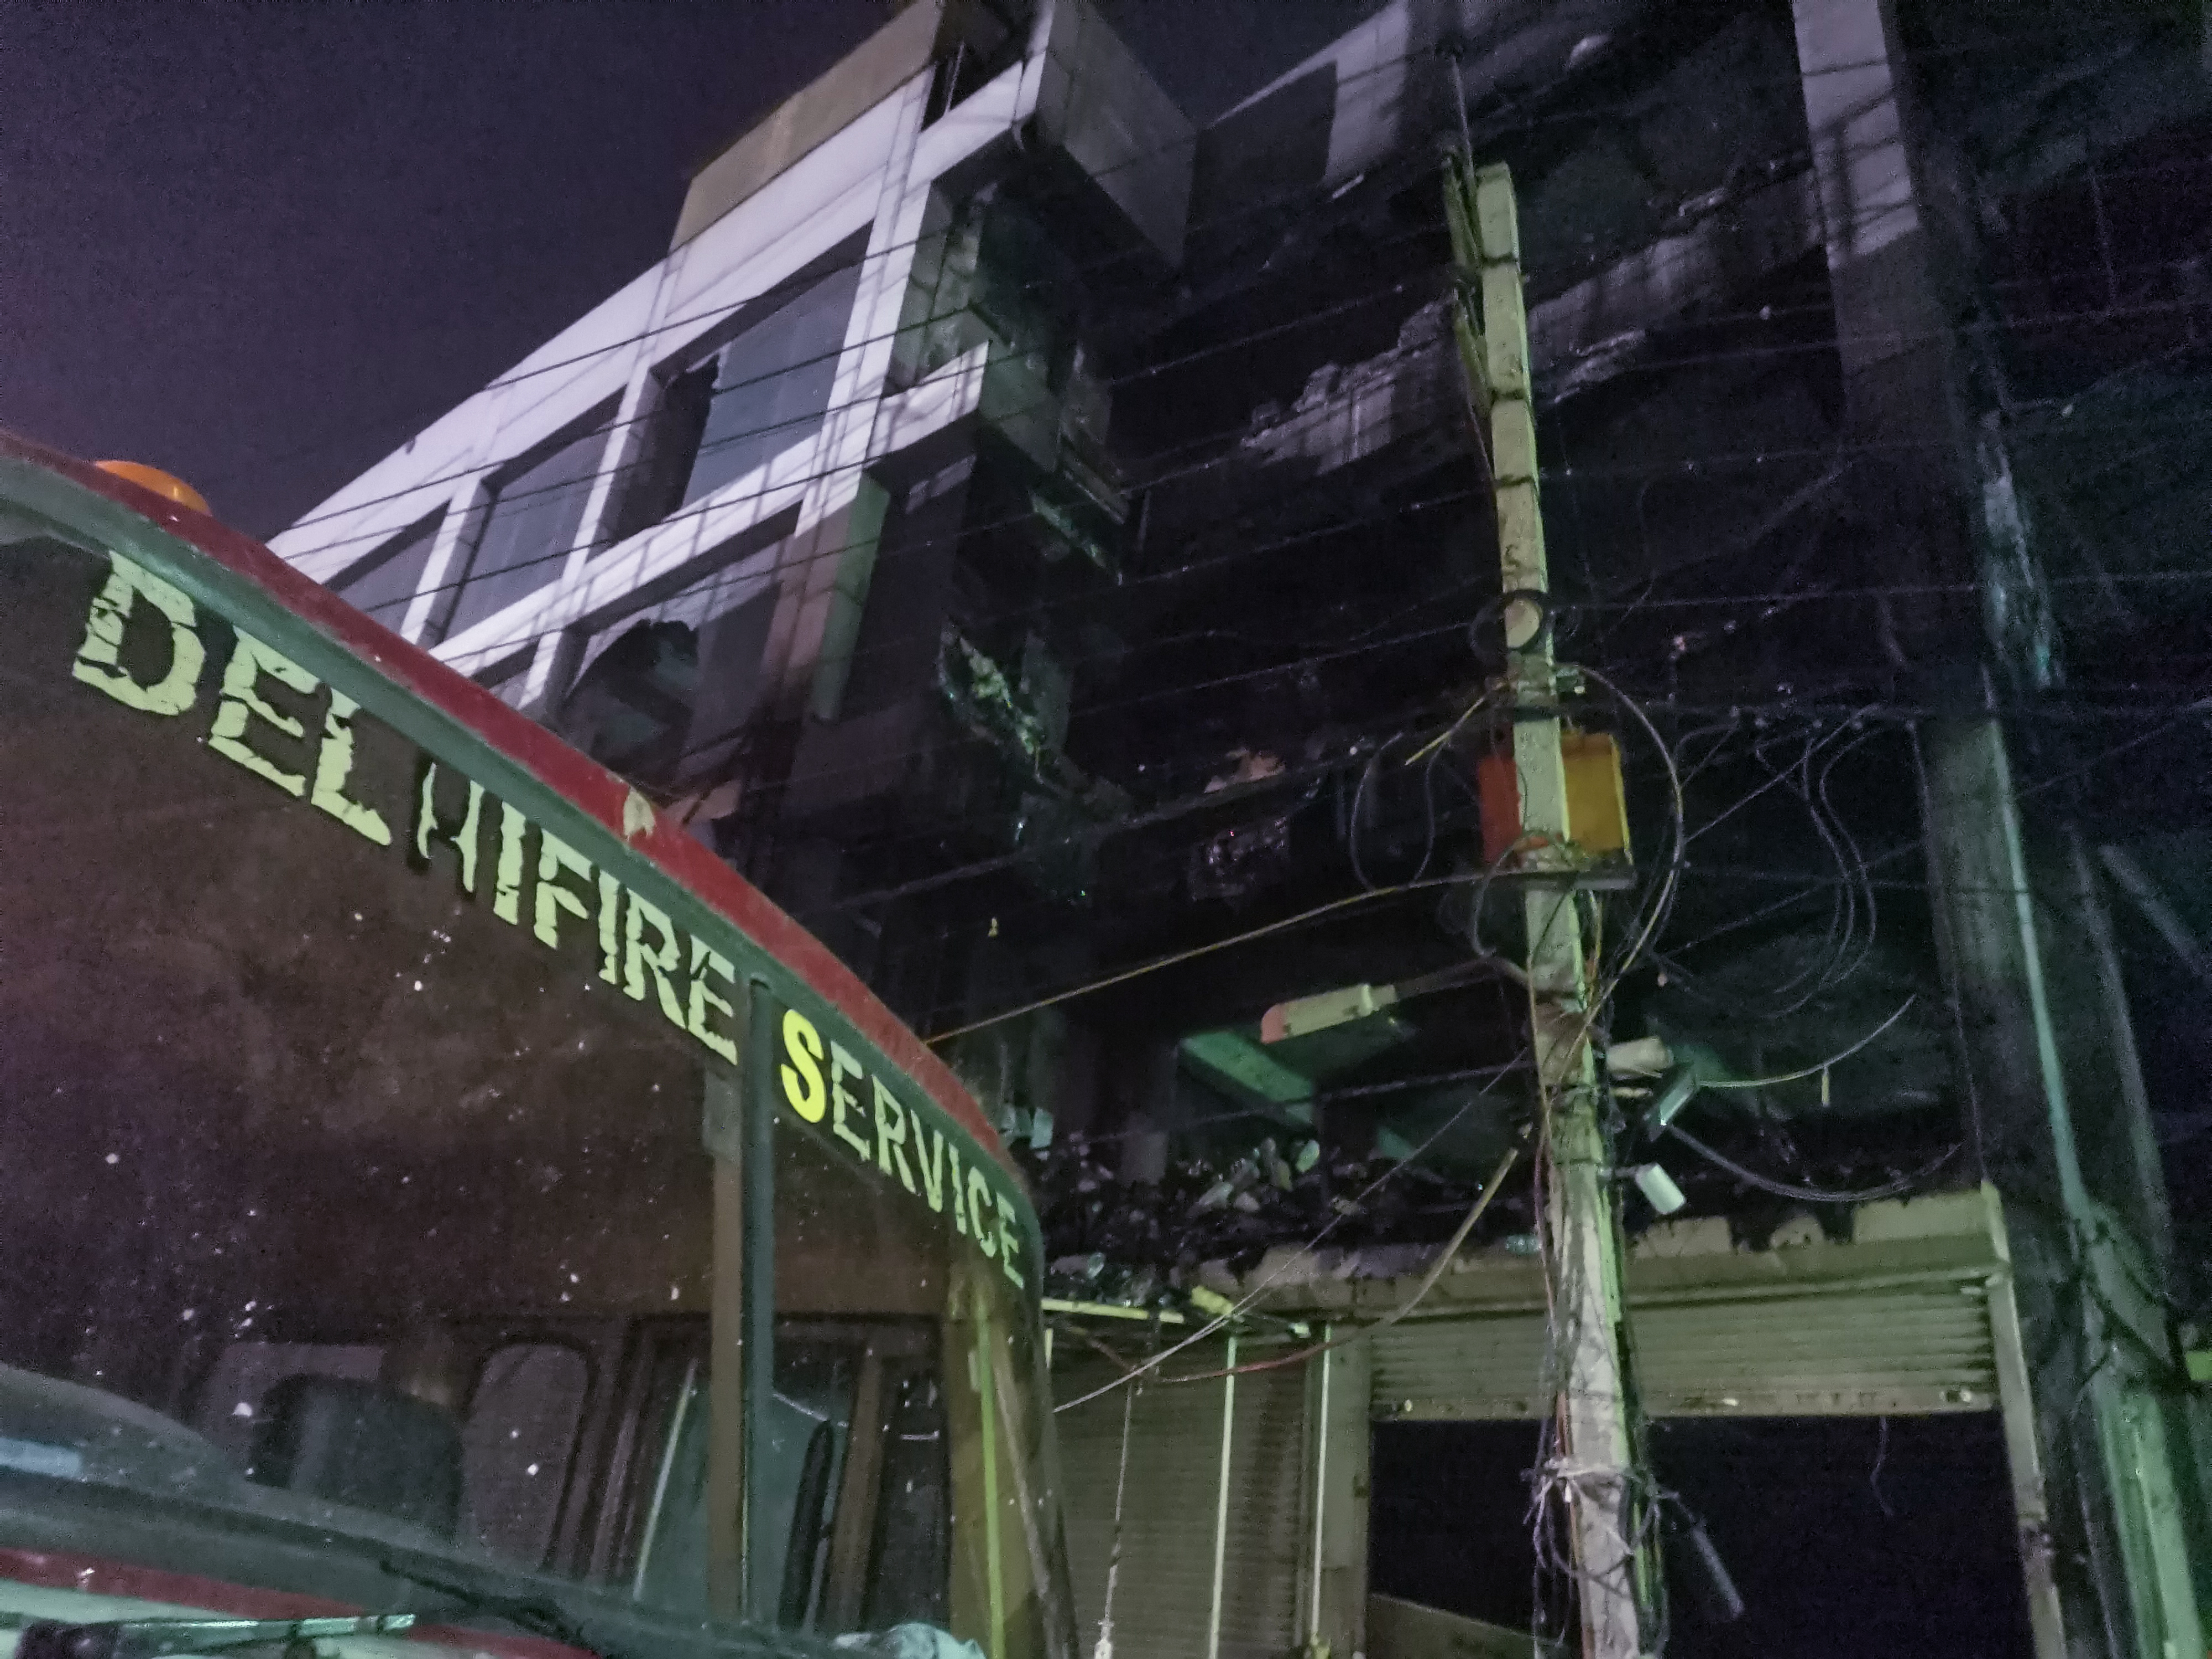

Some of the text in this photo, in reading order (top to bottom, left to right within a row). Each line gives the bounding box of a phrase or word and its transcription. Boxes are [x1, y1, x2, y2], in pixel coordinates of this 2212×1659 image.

[72, 550, 1023, 1289] DELHI FIRE SERVICE
